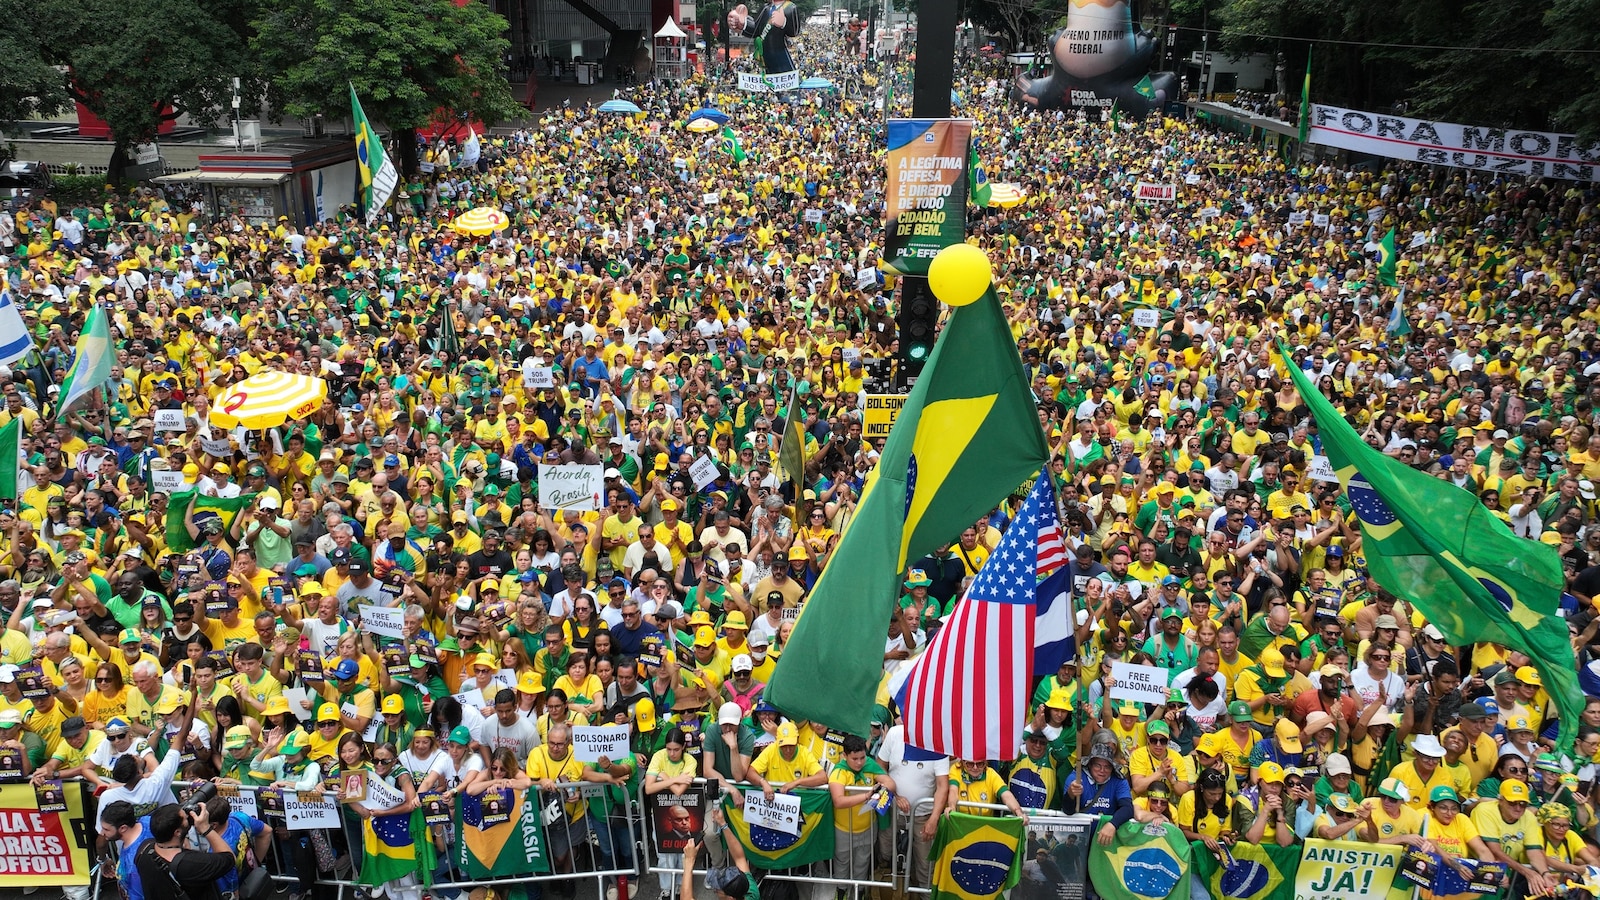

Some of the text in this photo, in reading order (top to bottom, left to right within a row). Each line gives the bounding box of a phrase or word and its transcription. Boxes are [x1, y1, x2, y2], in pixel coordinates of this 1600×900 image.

[1069, 43, 1104, 54] FEDERAL
[1071, 89, 1096, 99] FORA
[1071, 98, 1112, 107] MORAES
[1316, 106, 1443, 146] FORA
[898, 154, 962, 170] A LEGÍTIMA
[898, 170, 942, 182] DEFESA
[898, 183, 952, 197] É DIREITO
[1139, 186, 1163, 198] ANISTIA
[897, 197, 944, 209] DE TODO
[897, 209, 946, 223] CIDADÃO
[896, 223, 942, 237] DE BEM.
[296, 402, 316, 417] SKOL
[162, 413, 175, 421] SOS
[696, 469, 710, 482] LIVRE
[548, 483, 591, 506] Brasil!
[372, 612, 389, 621] FREE
[361, 617, 403, 631] BOLSONARO
[1128, 671, 1150, 682] FREE
[1113, 679, 1164, 694] BOLSONARO
[574, 733, 627, 743] BOLSONARO
[588, 744, 614, 753] LIVRE
[366, 778, 404, 803] BOLSONARO
[286, 801, 335, 811] BOLSONARO
[372, 792, 390, 808] LIVRE
[747, 795, 798, 815] BOLSONARO
[300, 810, 325, 819] LIVRE
[758, 807, 783, 821] LIVRE
[30, 812, 45, 832] E
[1049, 824, 1085, 833] LIBERDADE
[520, 801, 541, 864] BRASIL
[662, 840, 673, 849] EU
[1305, 847, 1394, 868] ANISTIA
[1311, 865, 1373, 894] JÁ!
